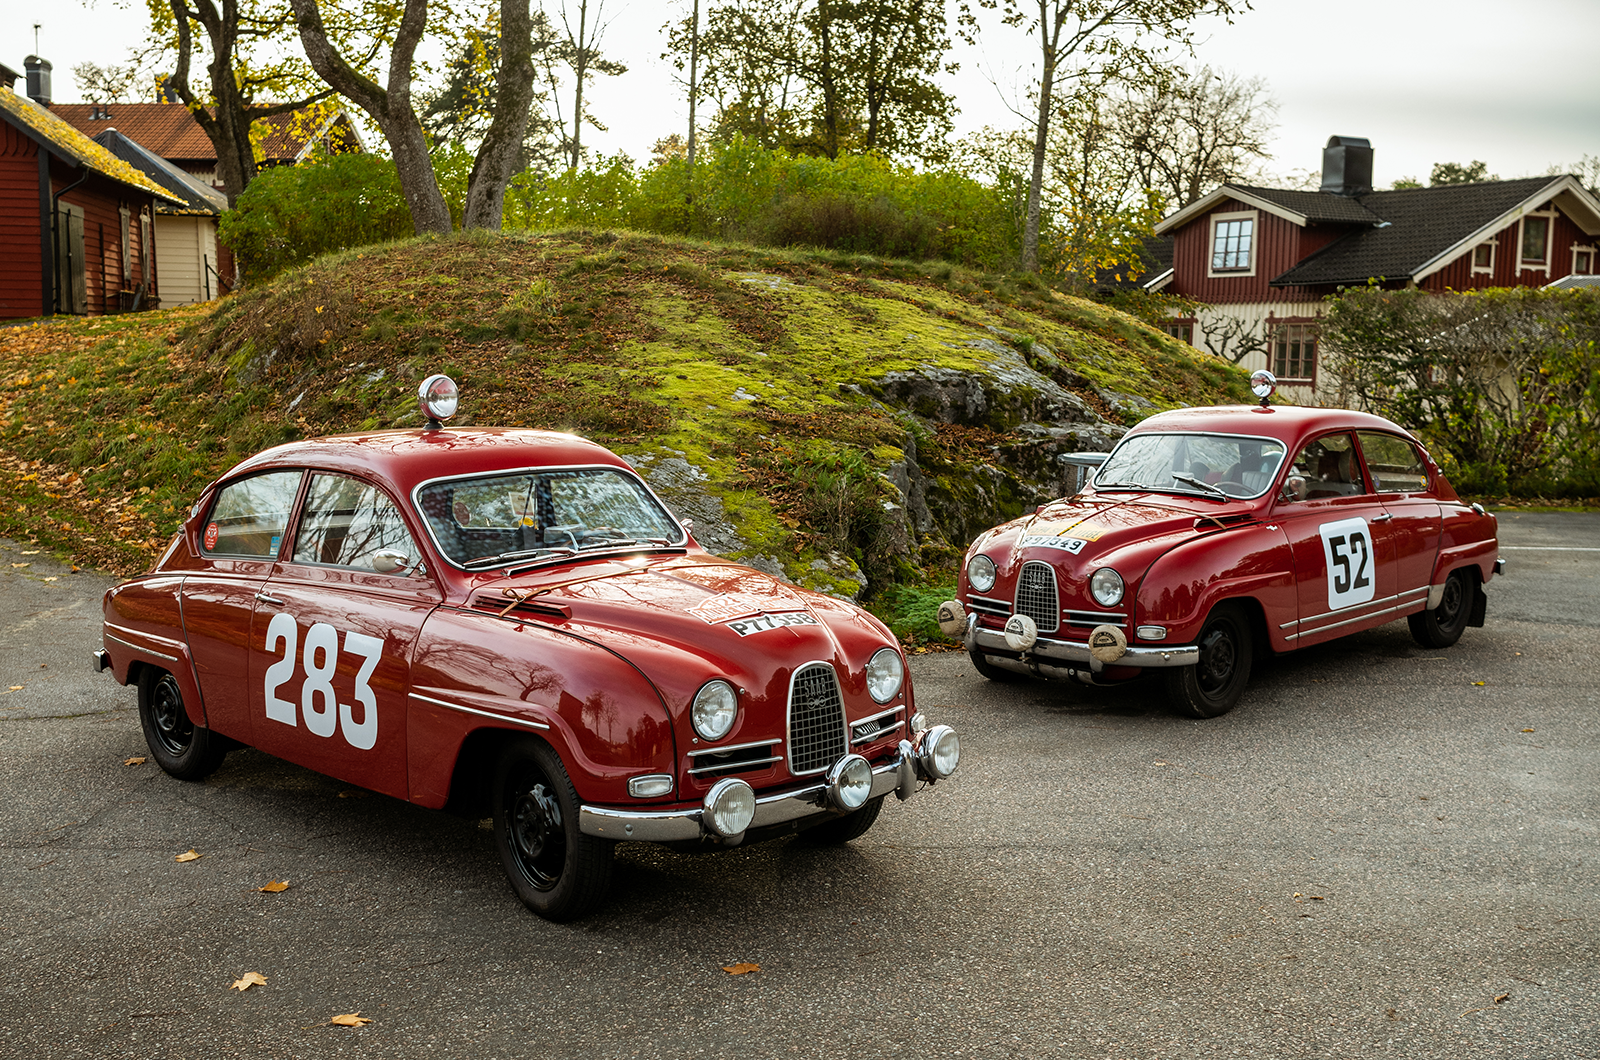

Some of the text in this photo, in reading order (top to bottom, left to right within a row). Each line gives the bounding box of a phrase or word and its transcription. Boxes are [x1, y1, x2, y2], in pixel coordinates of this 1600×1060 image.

[1329, 531, 1370, 594] 52
[729, 612, 817, 636] P77558
[264, 612, 385, 750] 283
[804, 677, 826, 697] SAAB
